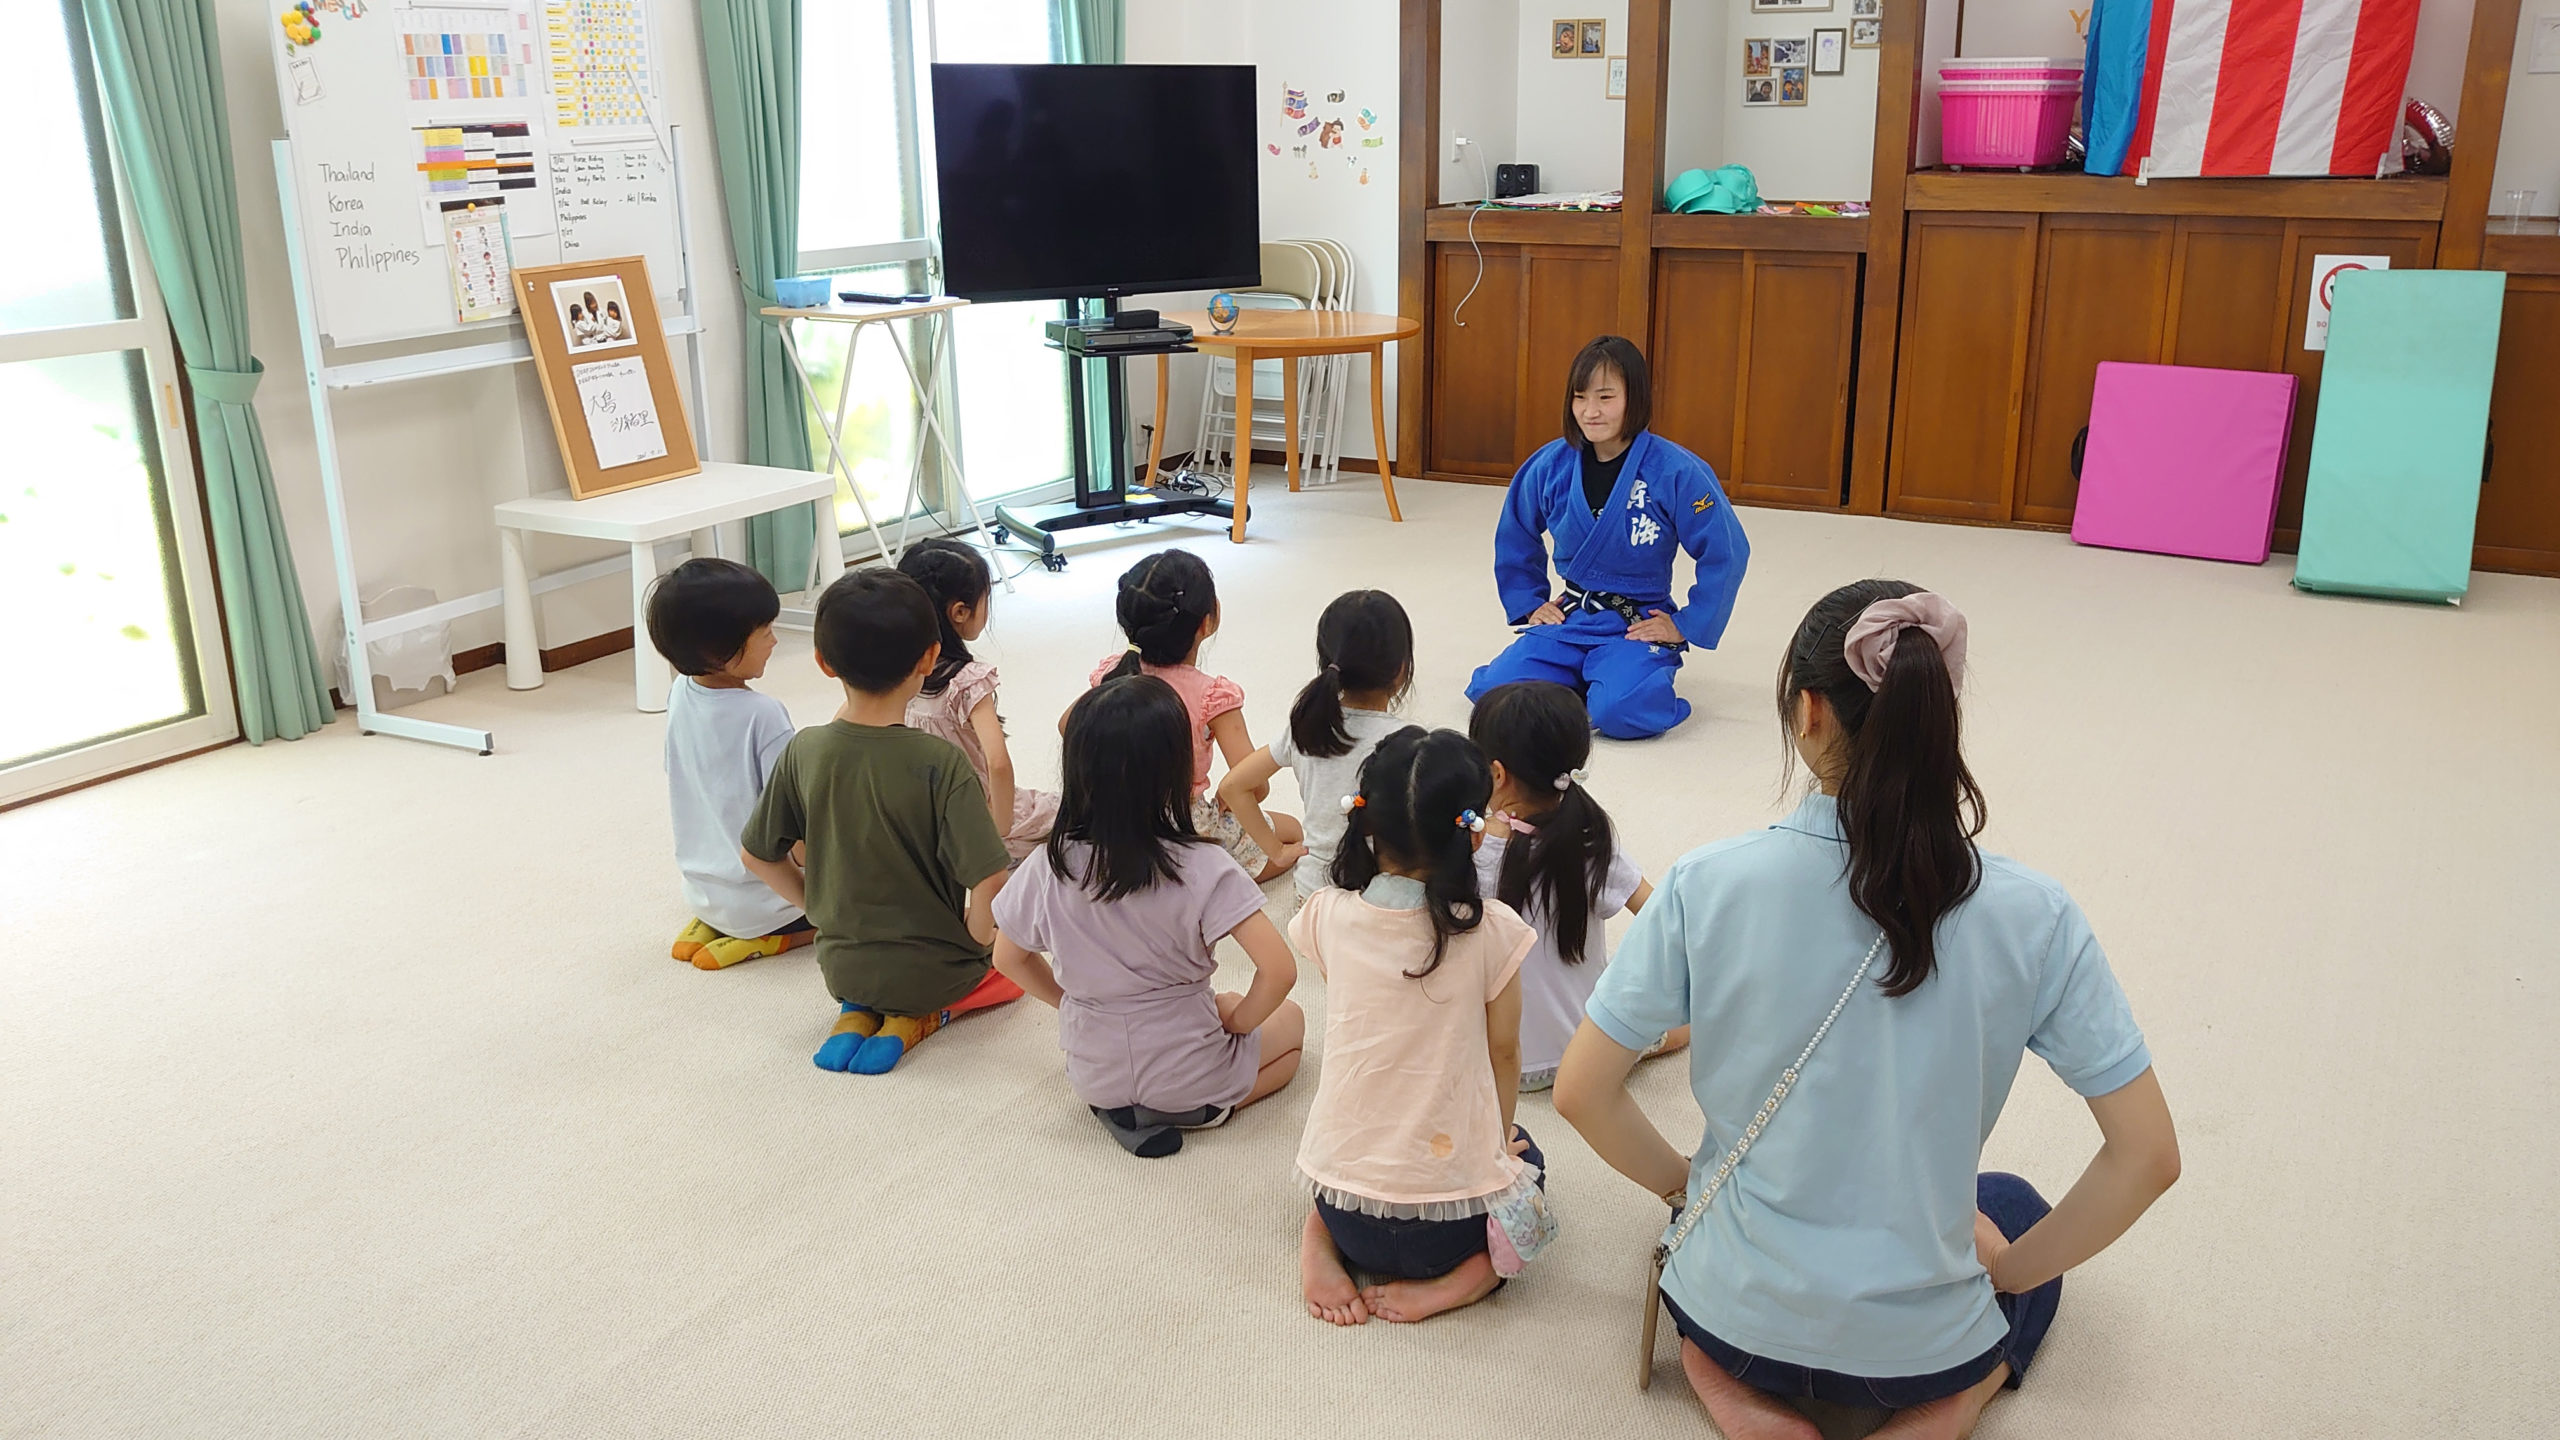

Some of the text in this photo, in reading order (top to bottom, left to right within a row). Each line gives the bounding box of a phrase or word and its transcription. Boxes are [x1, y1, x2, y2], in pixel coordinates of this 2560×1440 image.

[318, 161, 375, 183] Thailand
[555, 187, 571, 195] India
[328, 191, 364, 213] Korea
[330, 220, 372, 237] India
[564, 240, 580, 249] China
[336, 243, 420, 273] Philippines
